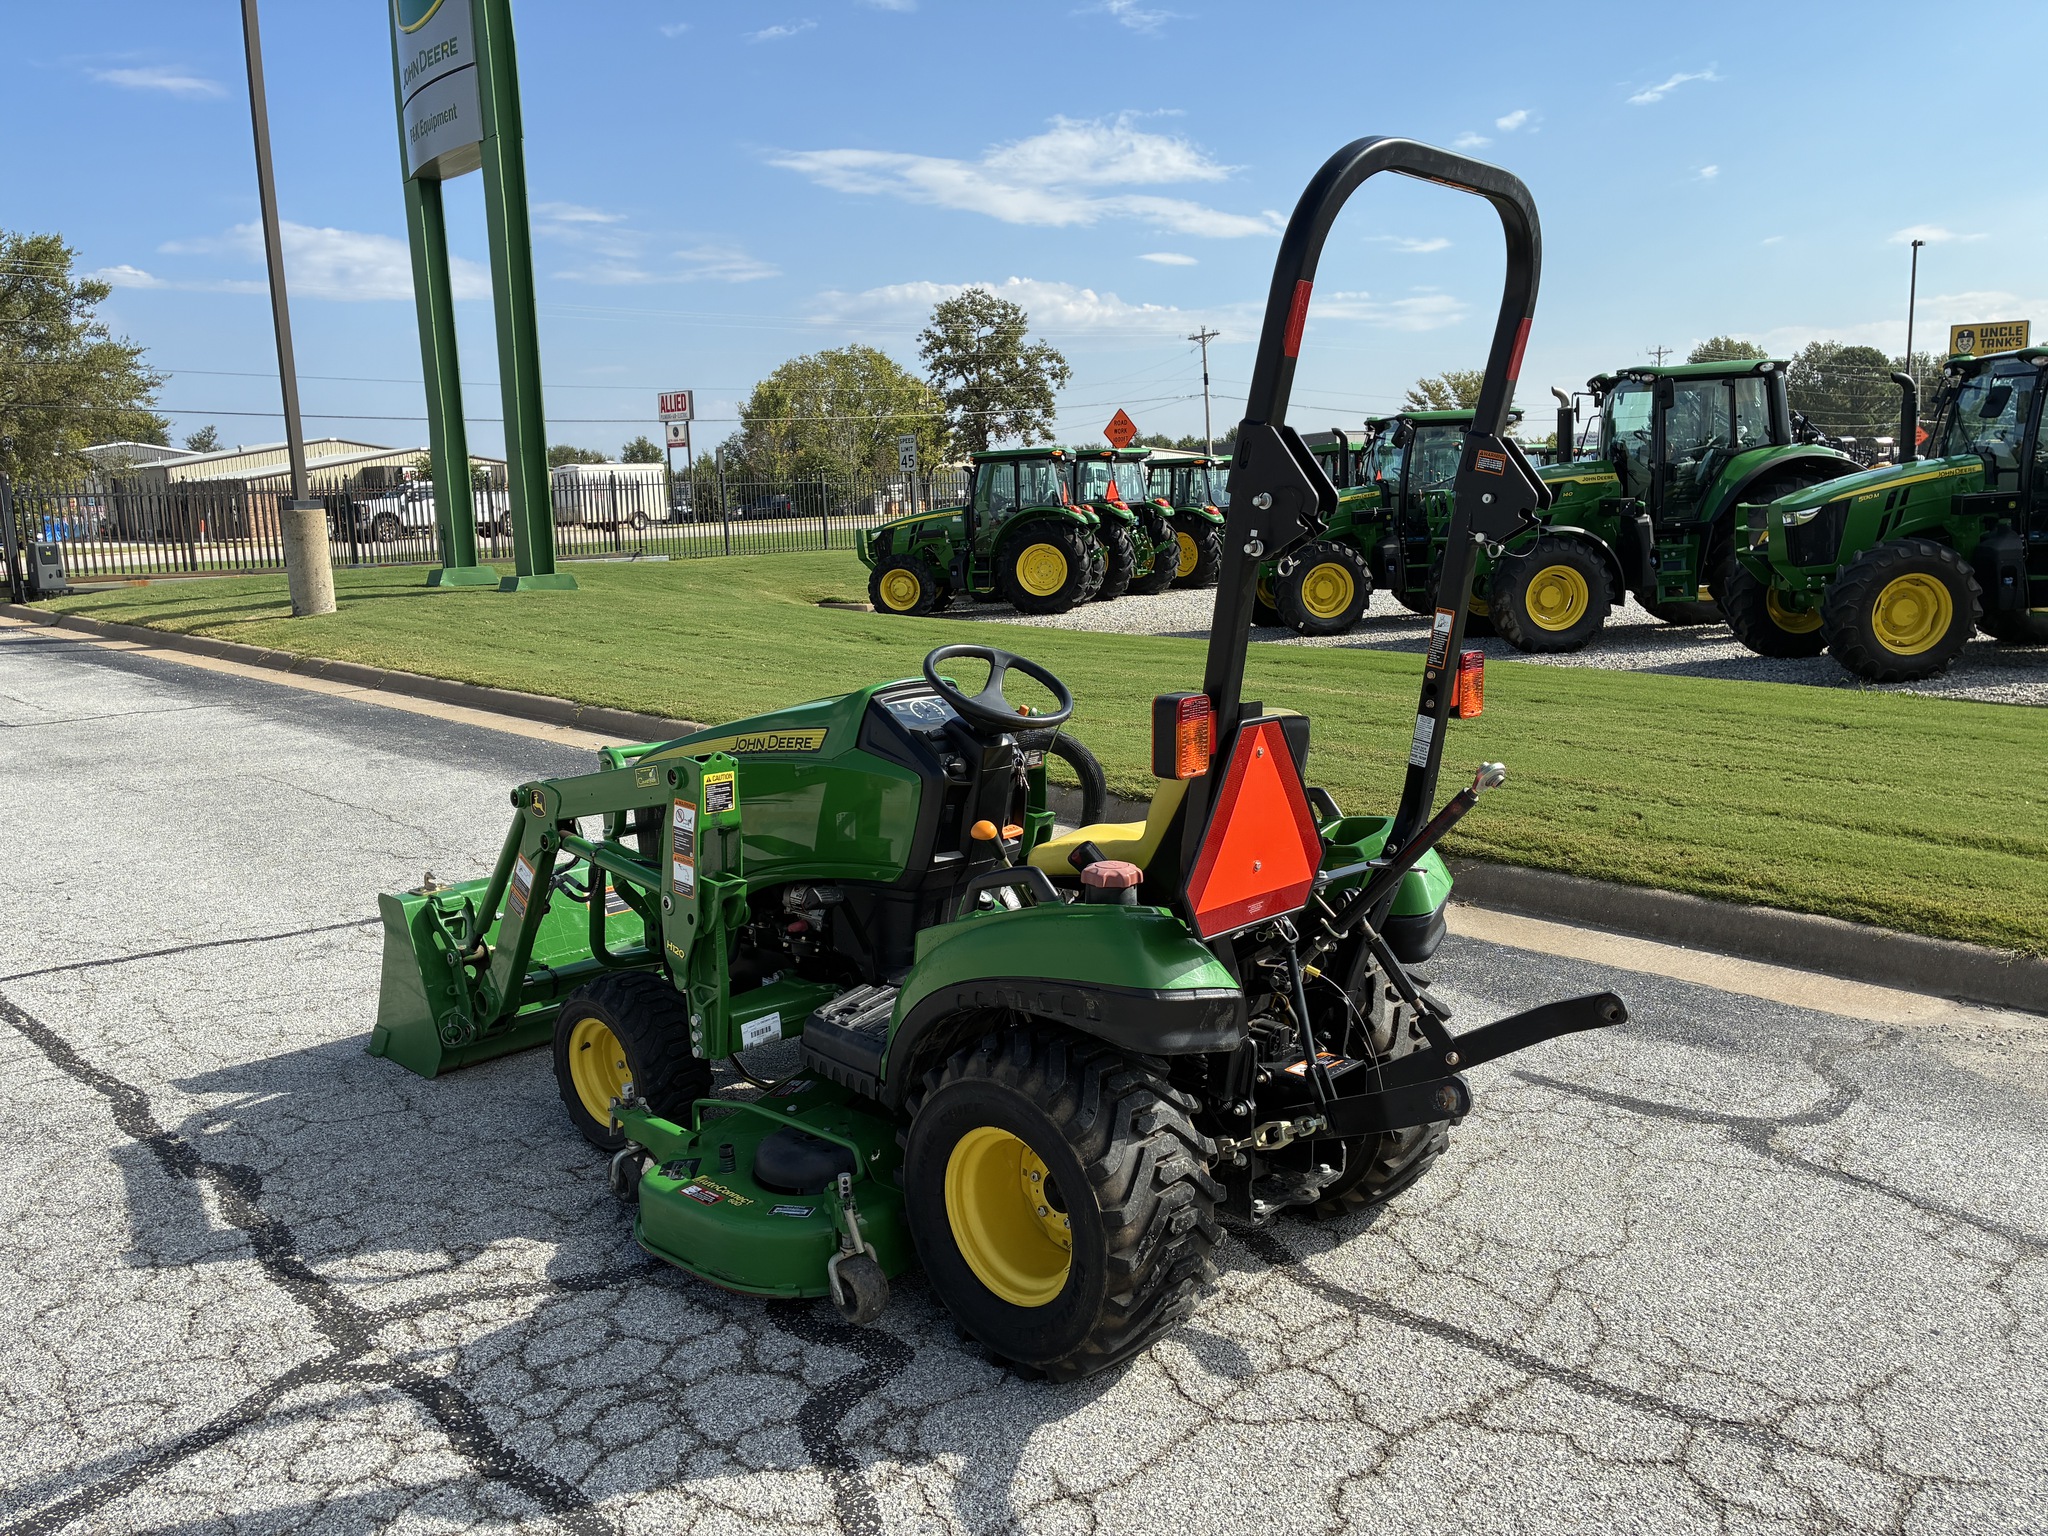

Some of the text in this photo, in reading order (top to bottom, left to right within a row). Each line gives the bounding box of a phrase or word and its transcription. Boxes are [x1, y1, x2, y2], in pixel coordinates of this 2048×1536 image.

[403, 37, 459, 89] JOHN DEERE
[420, 103, 457, 137] Equipment
[1980, 326, 2023, 337] UNCLE
[1980, 337, 2022, 348] TANK'S
[660, 393, 687, 413] ALLIED
[901, 454, 915, 469] 45
[1938, 466, 1976, 478] JOHN DEERE
[731, 735, 813, 751] JOHN DEERE
[712, 773, 733, 782] CAUTION
[666, 940, 685, 959] H120
